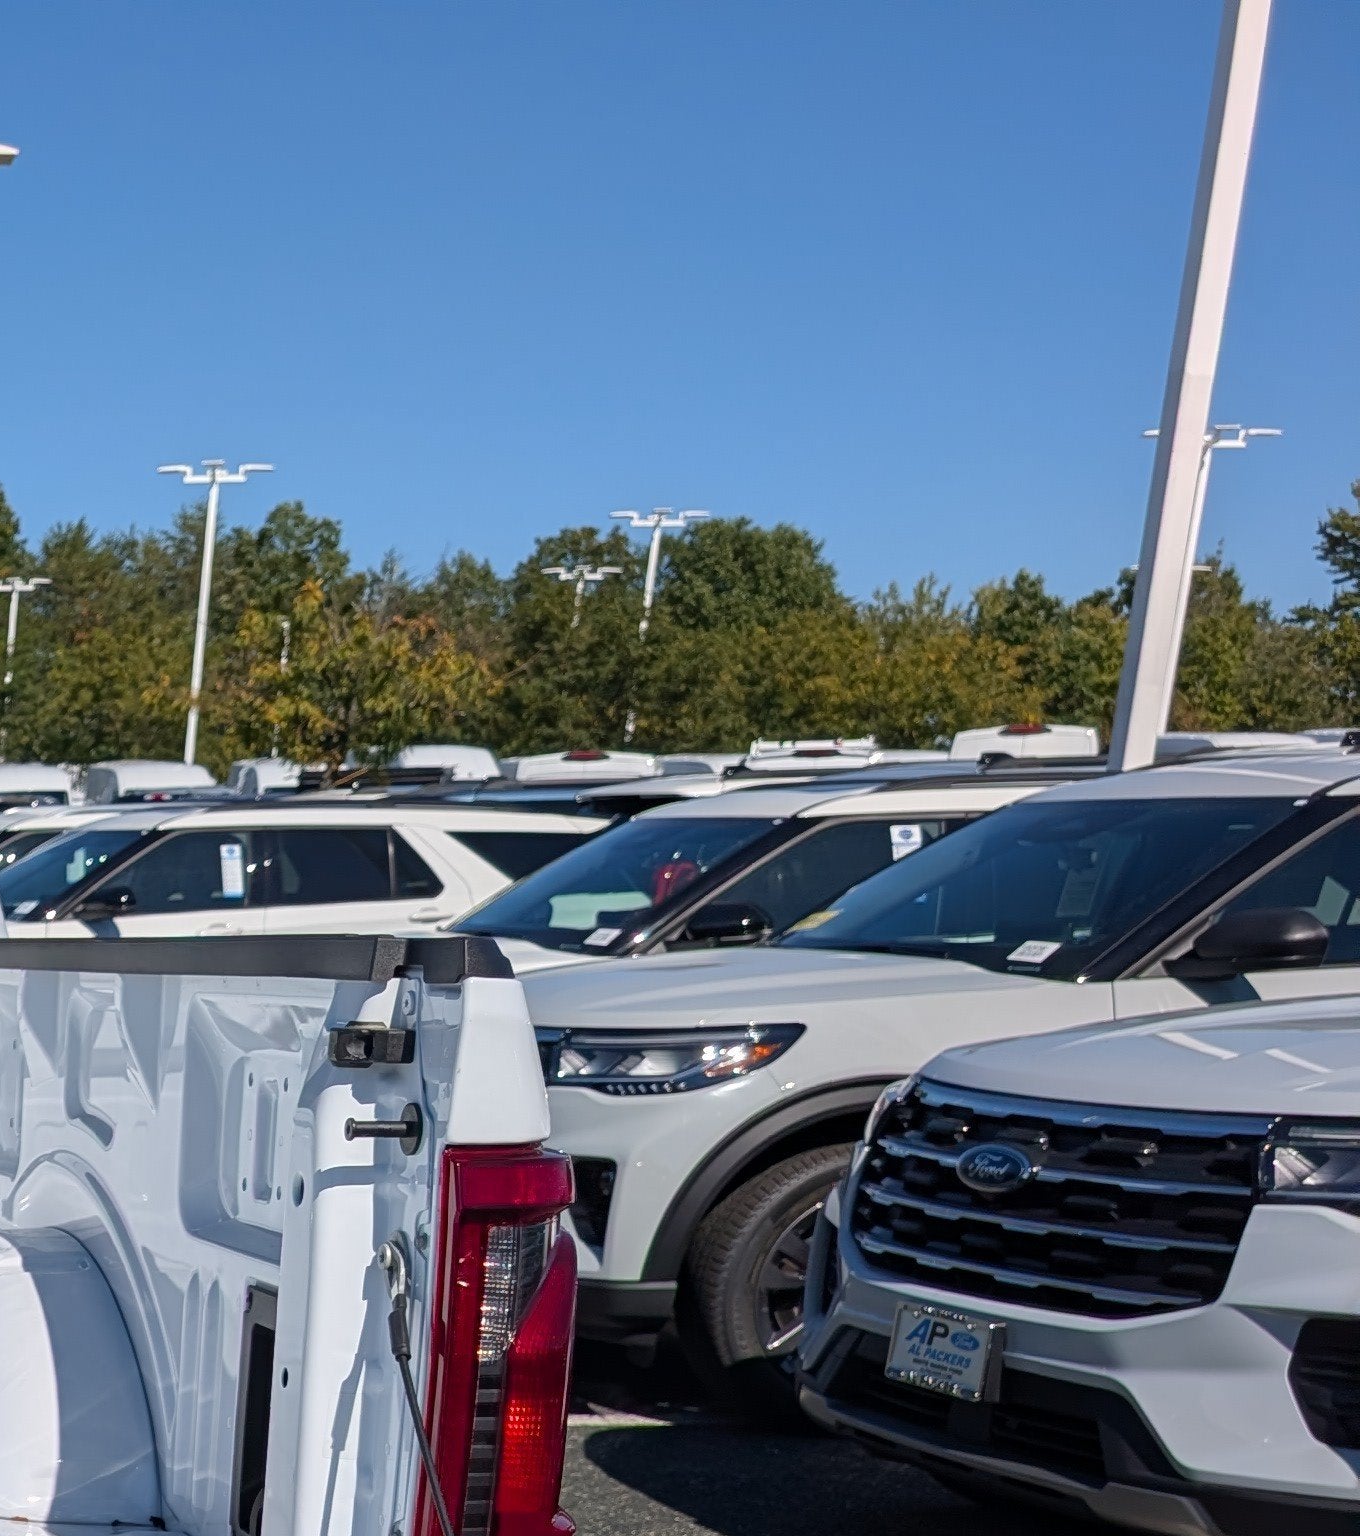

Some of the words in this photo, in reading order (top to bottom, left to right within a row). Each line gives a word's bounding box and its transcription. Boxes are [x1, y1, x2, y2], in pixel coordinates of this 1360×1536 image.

[968, 1152, 1010, 1179] Ford
[904, 1317, 950, 1346] AP
[923, 1347, 972, 1369] PACKERS
